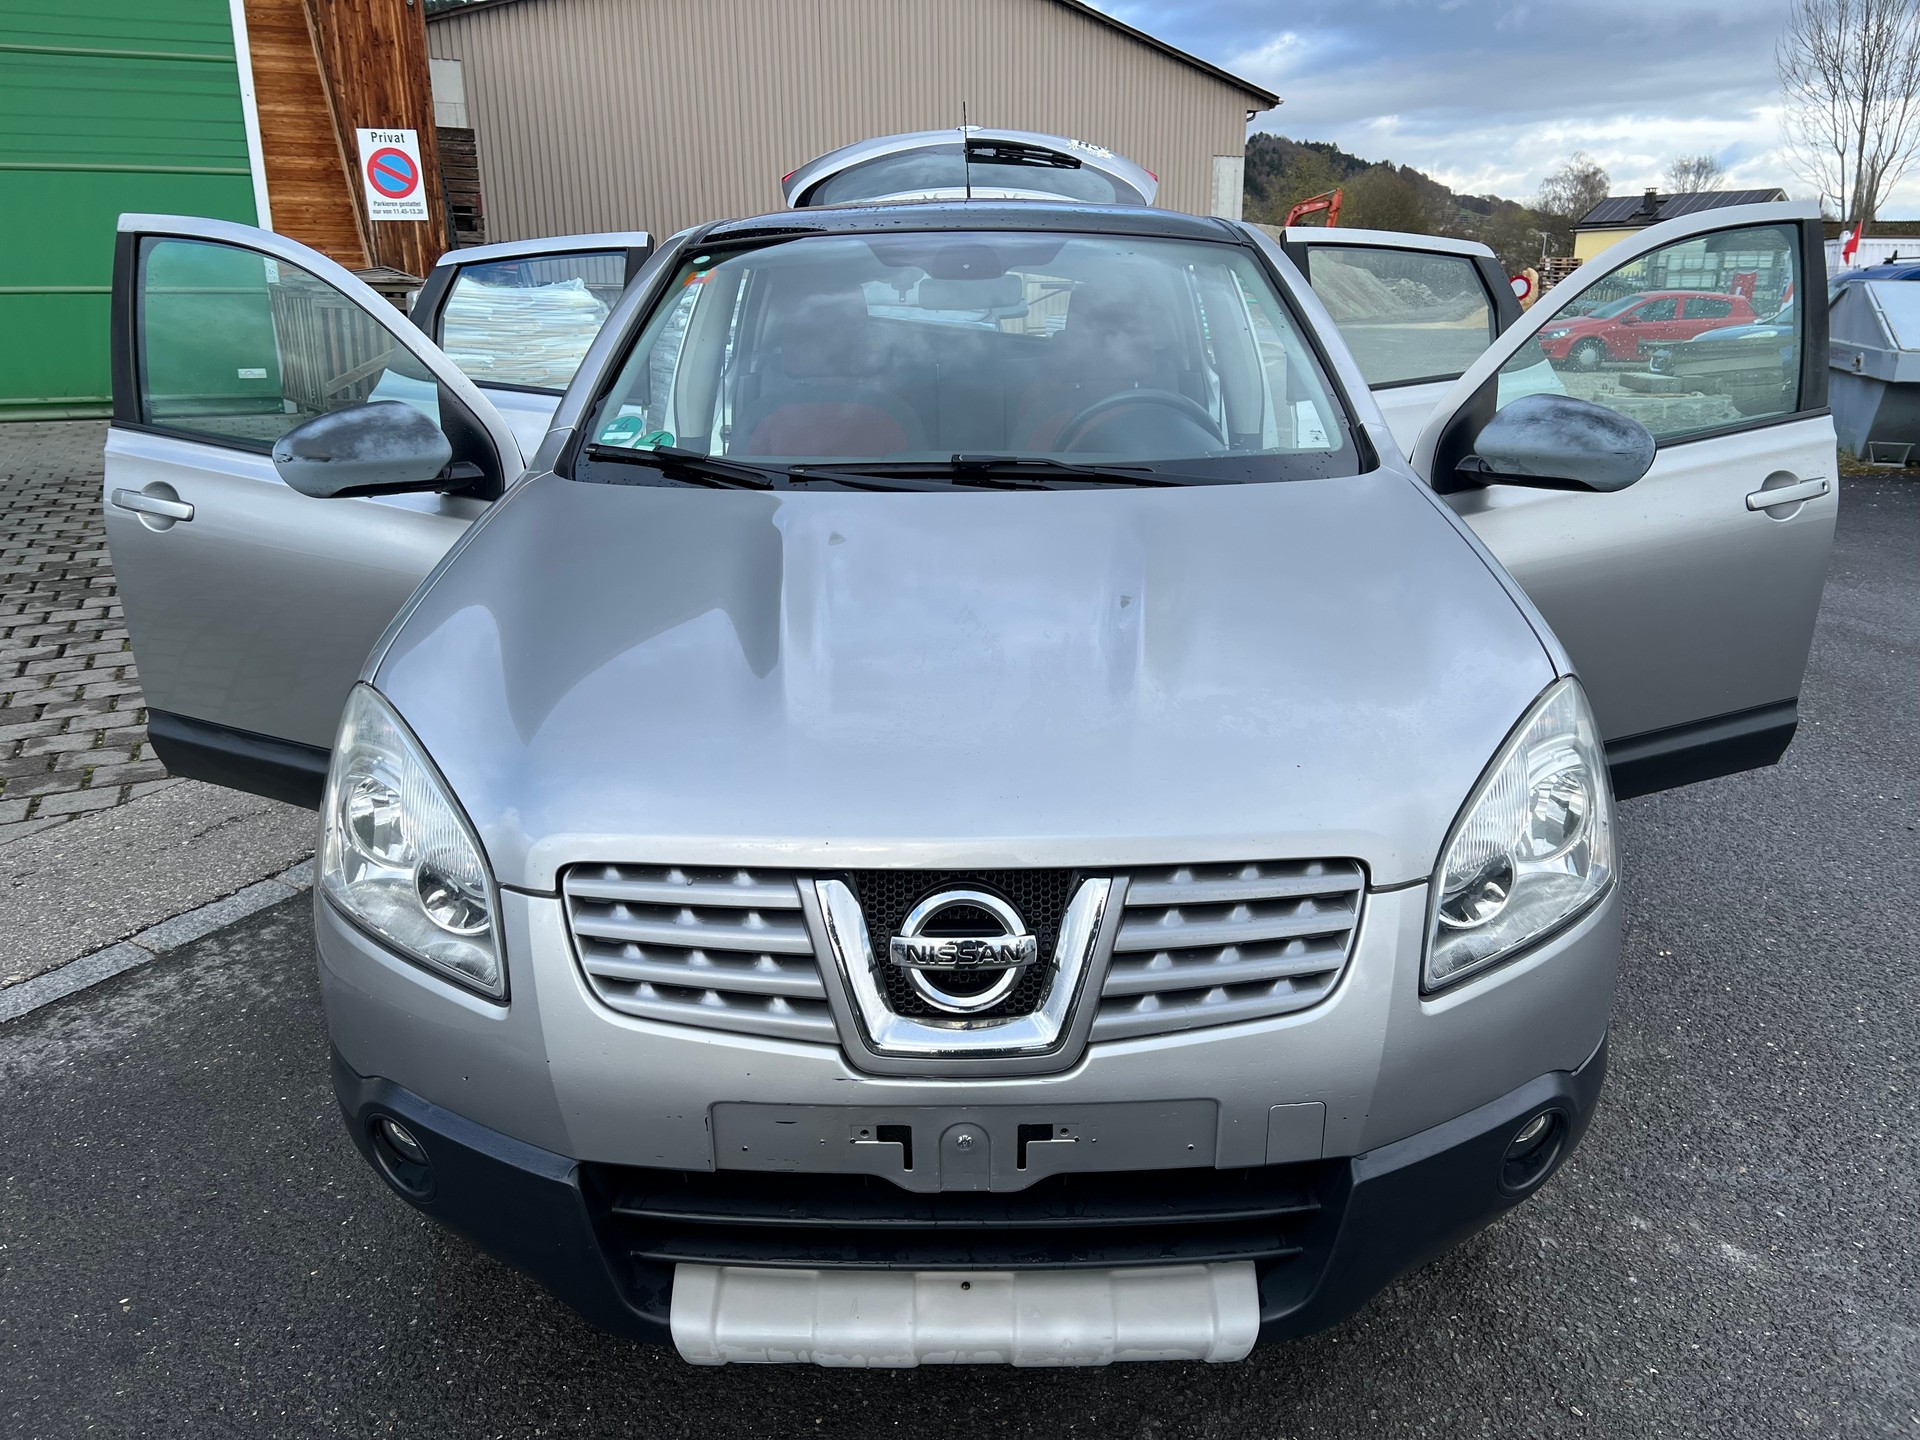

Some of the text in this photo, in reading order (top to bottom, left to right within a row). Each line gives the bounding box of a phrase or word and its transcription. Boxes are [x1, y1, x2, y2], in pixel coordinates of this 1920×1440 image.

[371, 132, 405, 143] Privat
[617, 418, 630, 430] 4
[650, 432, 667, 445] 4
[906, 944, 1023, 965] NISSAN
